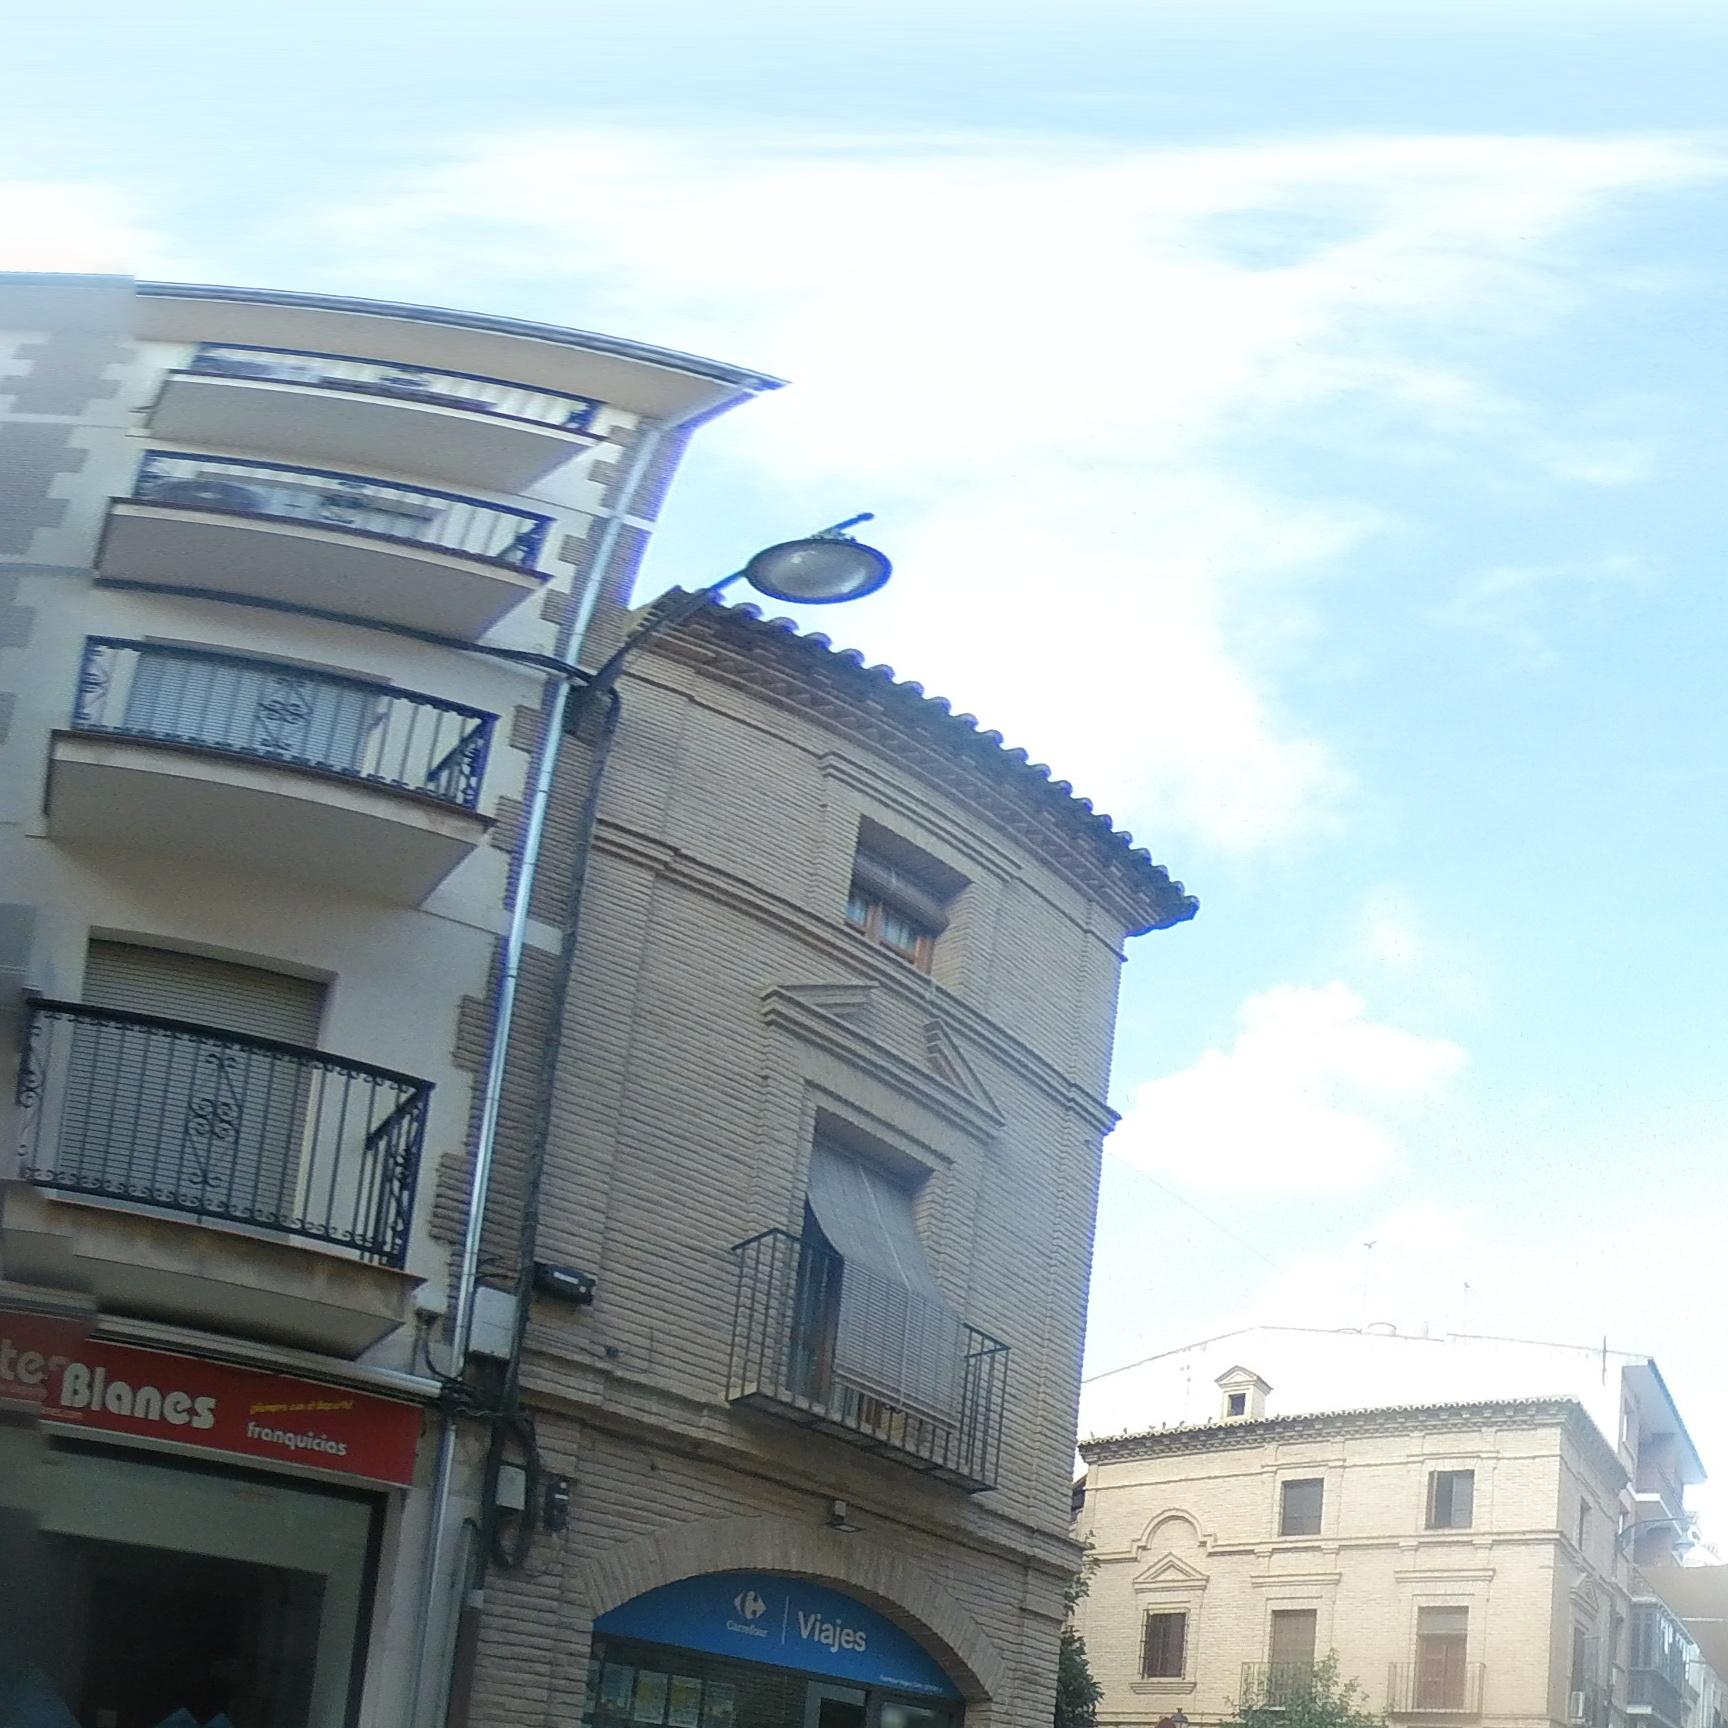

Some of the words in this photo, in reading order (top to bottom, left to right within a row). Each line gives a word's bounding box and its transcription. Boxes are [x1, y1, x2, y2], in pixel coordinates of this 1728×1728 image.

[60, 1362, 217, 1430] Blanes
[247, 1421, 348, 1456] franquicias
[797, 1610, 867, 1653] Viajes
